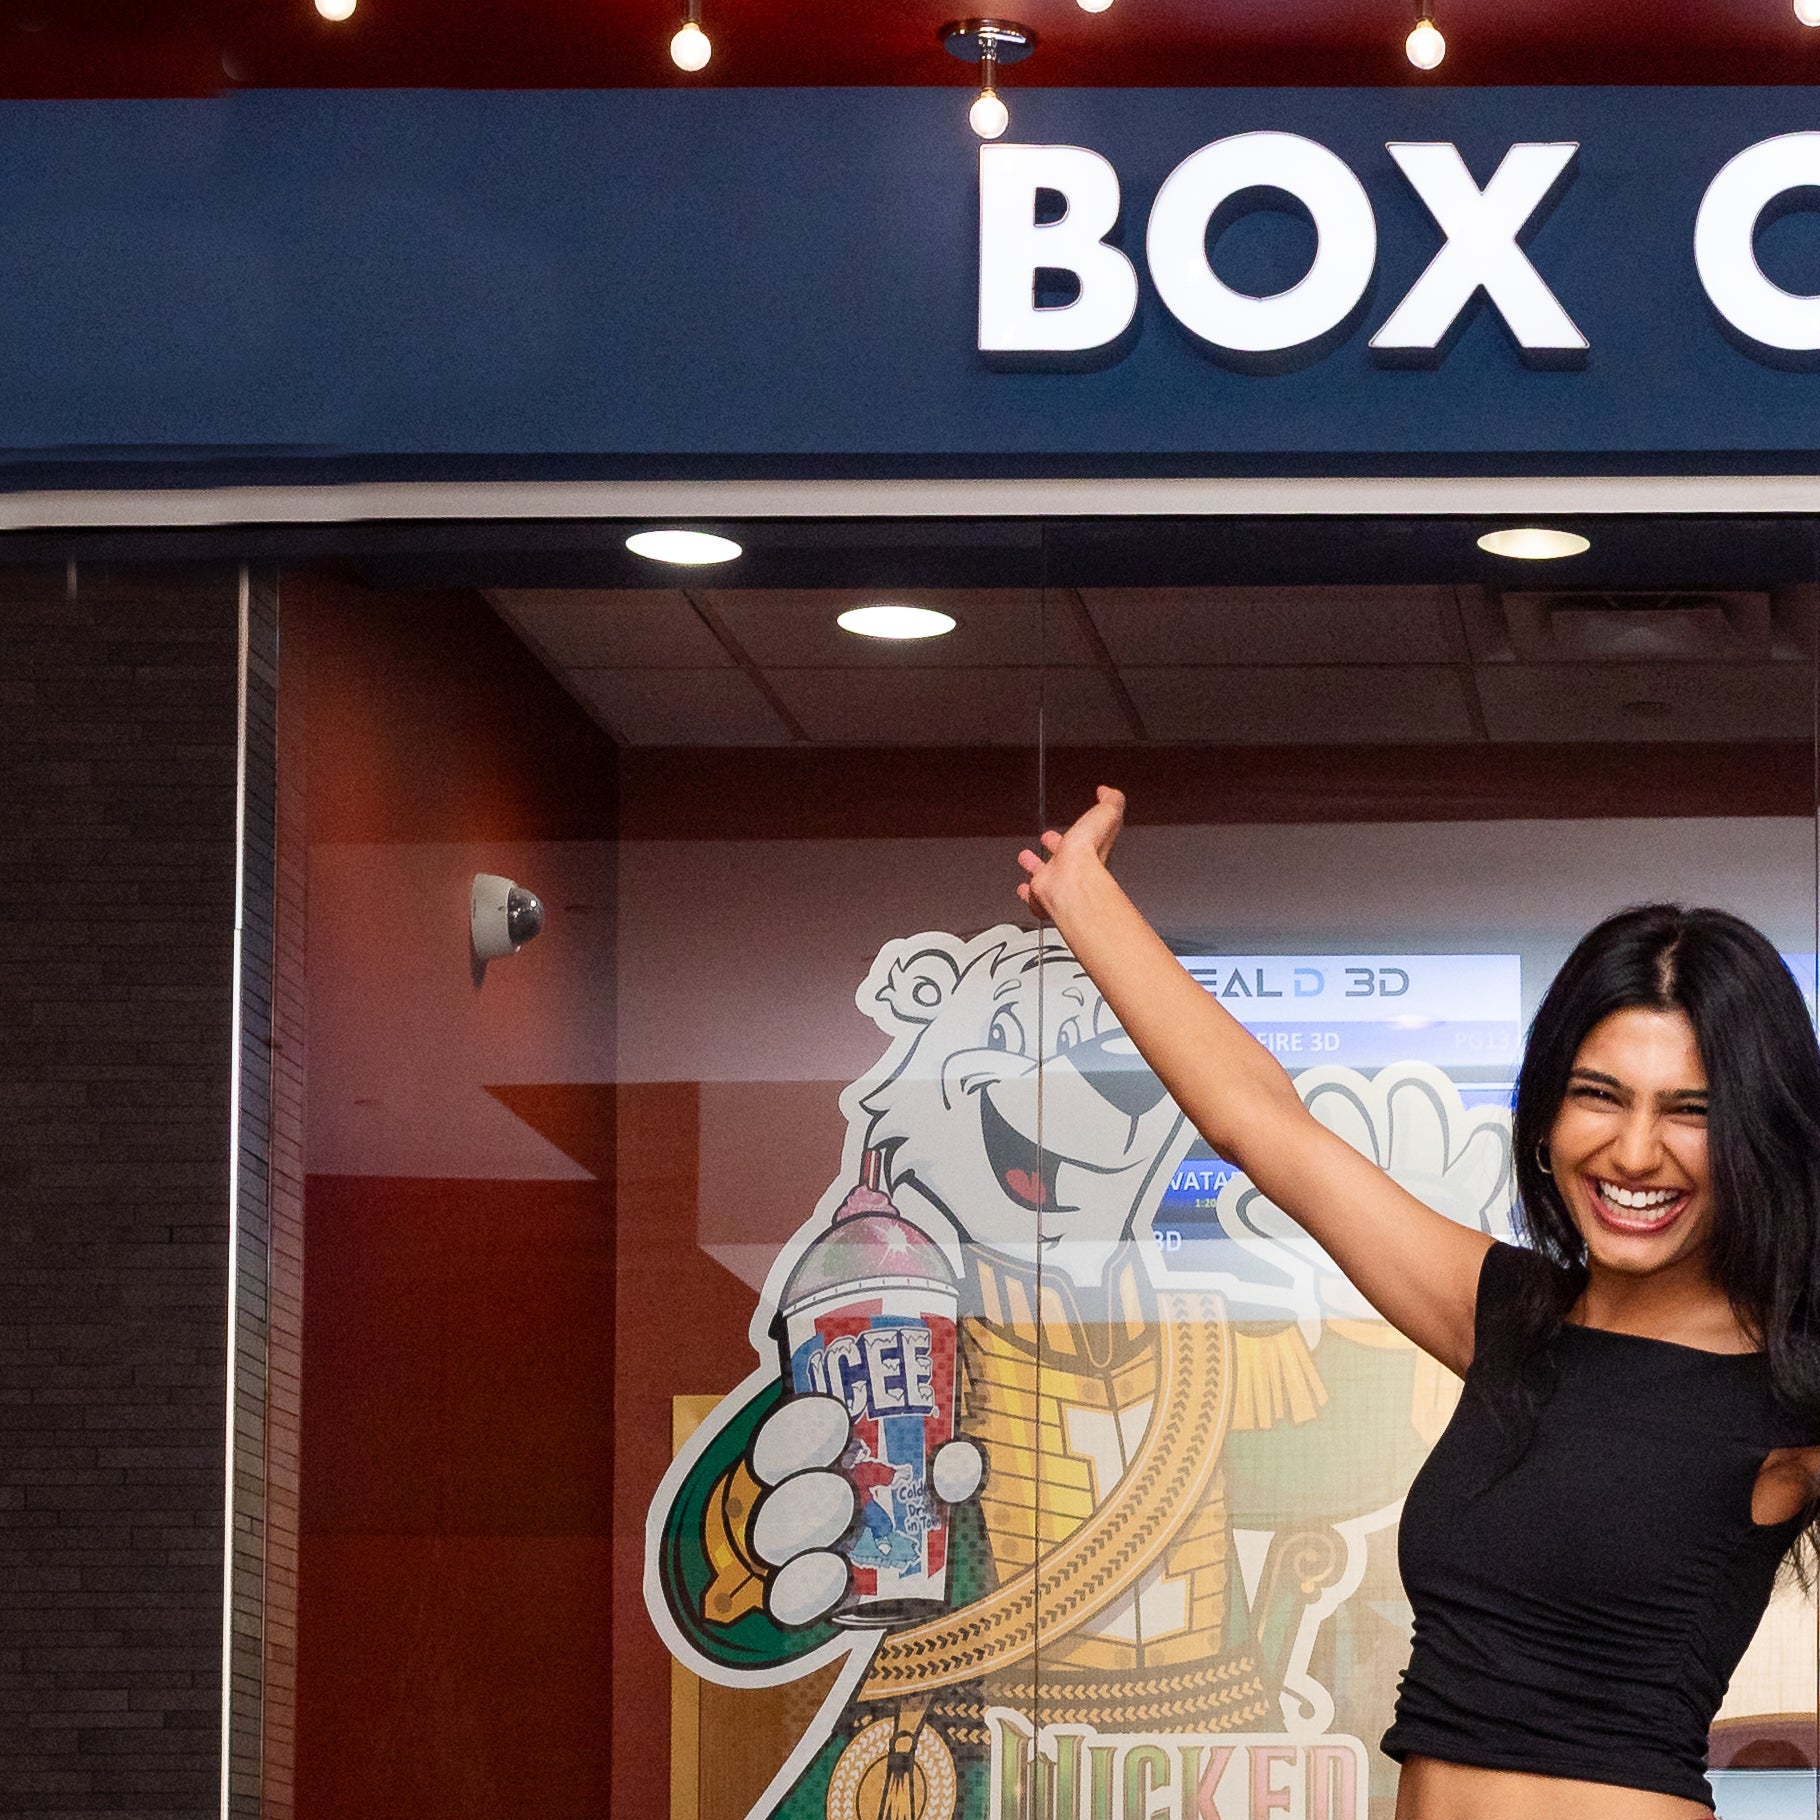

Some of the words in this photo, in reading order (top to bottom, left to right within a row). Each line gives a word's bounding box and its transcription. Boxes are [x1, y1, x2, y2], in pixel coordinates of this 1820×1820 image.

[977, 130, 1588, 352] BOX
[1188, 967, 1282, 998] EAL
[1345, 967, 1410, 997] 3D
[1311, 1033, 1340, 1051] 3D
[1170, 1171, 1243, 1191] VATA
[1195, 1198, 1217, 1208] 1:20
[808, 1328, 934, 1418] ICEE
